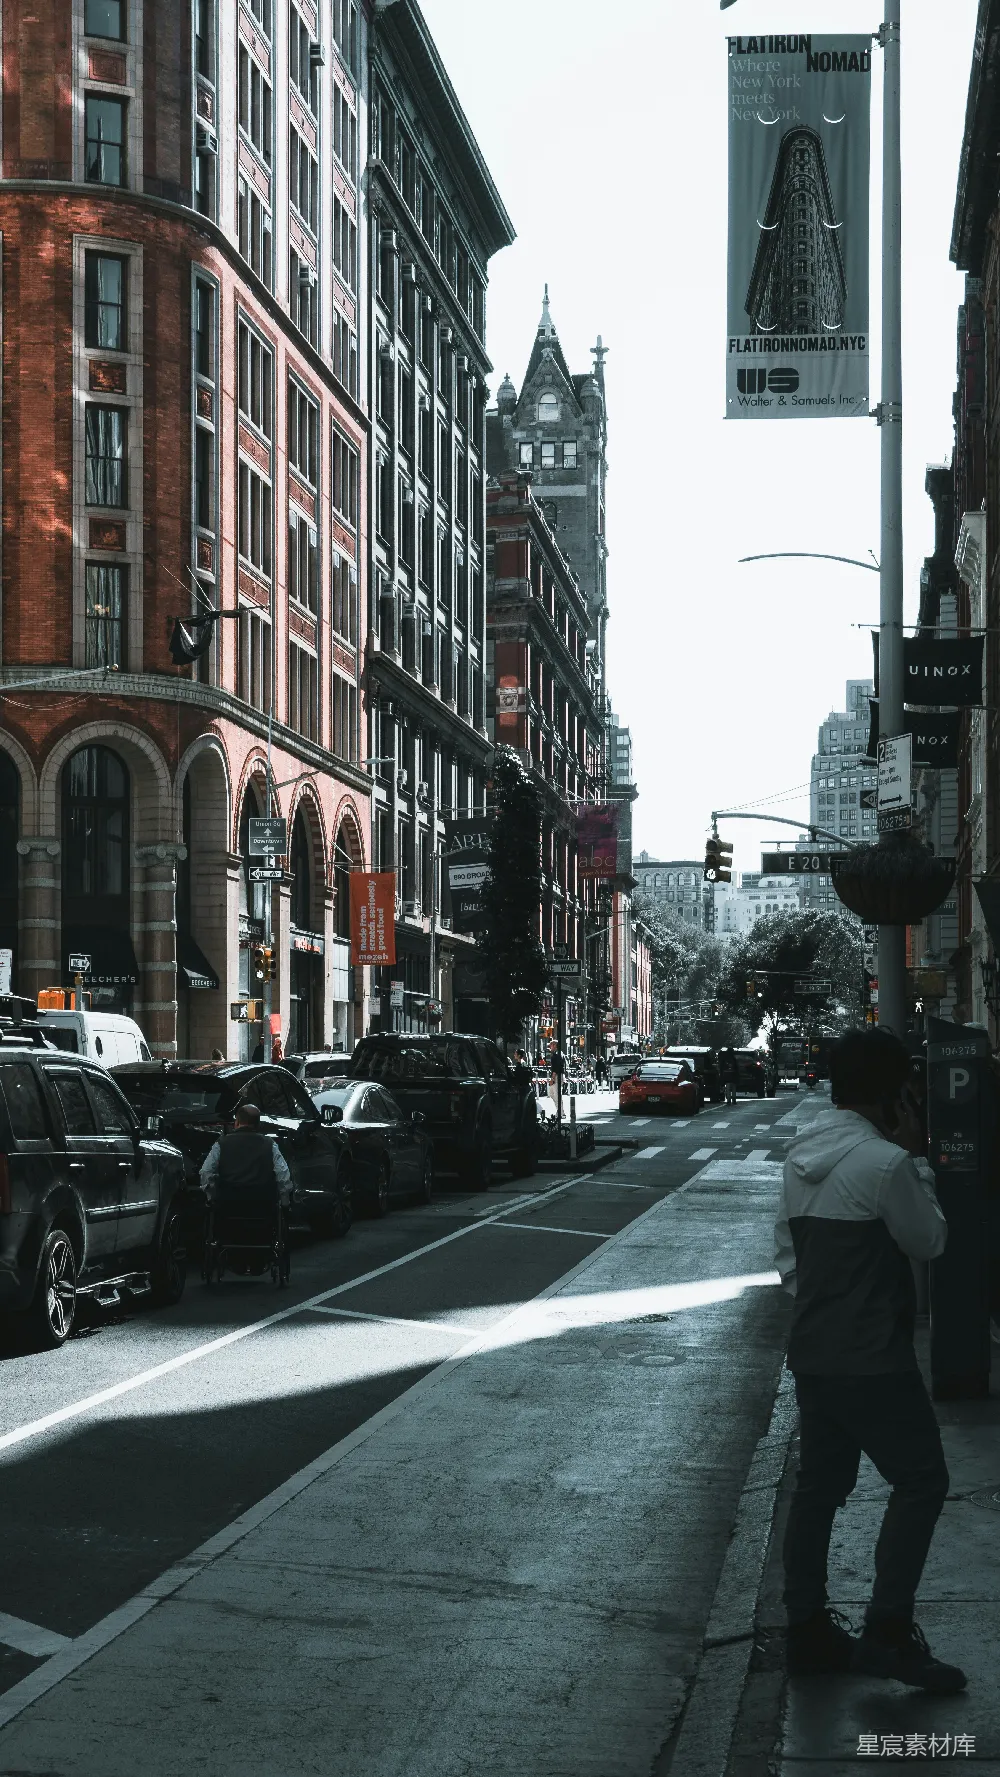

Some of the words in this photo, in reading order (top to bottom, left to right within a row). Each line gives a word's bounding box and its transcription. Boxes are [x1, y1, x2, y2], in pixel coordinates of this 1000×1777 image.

[728, 34, 811, 54] FLATIRON
[732, 58, 780, 72] Where
[806, 51, 871, 73] NOMAD
[732, 76, 763, 88] New
[768, 74, 801, 88] York
[731, 93, 775, 104] meets
[732, 107, 763, 120] New
[768, 106, 801, 120] York
[728, 336, 866, 353] FLATIRONNOMAD.NYC
[738, 395, 774, 407] Walter
[778, 395, 787, 406] &
[791, 394, 836, 406] Samuels
[840, 394, 858, 404] Inc.
[908, 664, 972, 677] UINOX
[917, 735, 949, 745] NOX
[879, 743, 885, 763] 2
[578, 845, 615, 868] abc
[788, 856, 796, 870] E
[802, 856, 820, 870] 20
[377, 929, 387, 951] good
[560, 964, 576, 972] WAY
[84, 974, 136, 983] EECHER'S
[941, 1045, 977, 1056] 106275
[949, 1067, 970, 1099] P
[941, 1143, 974, 1152] 106275
